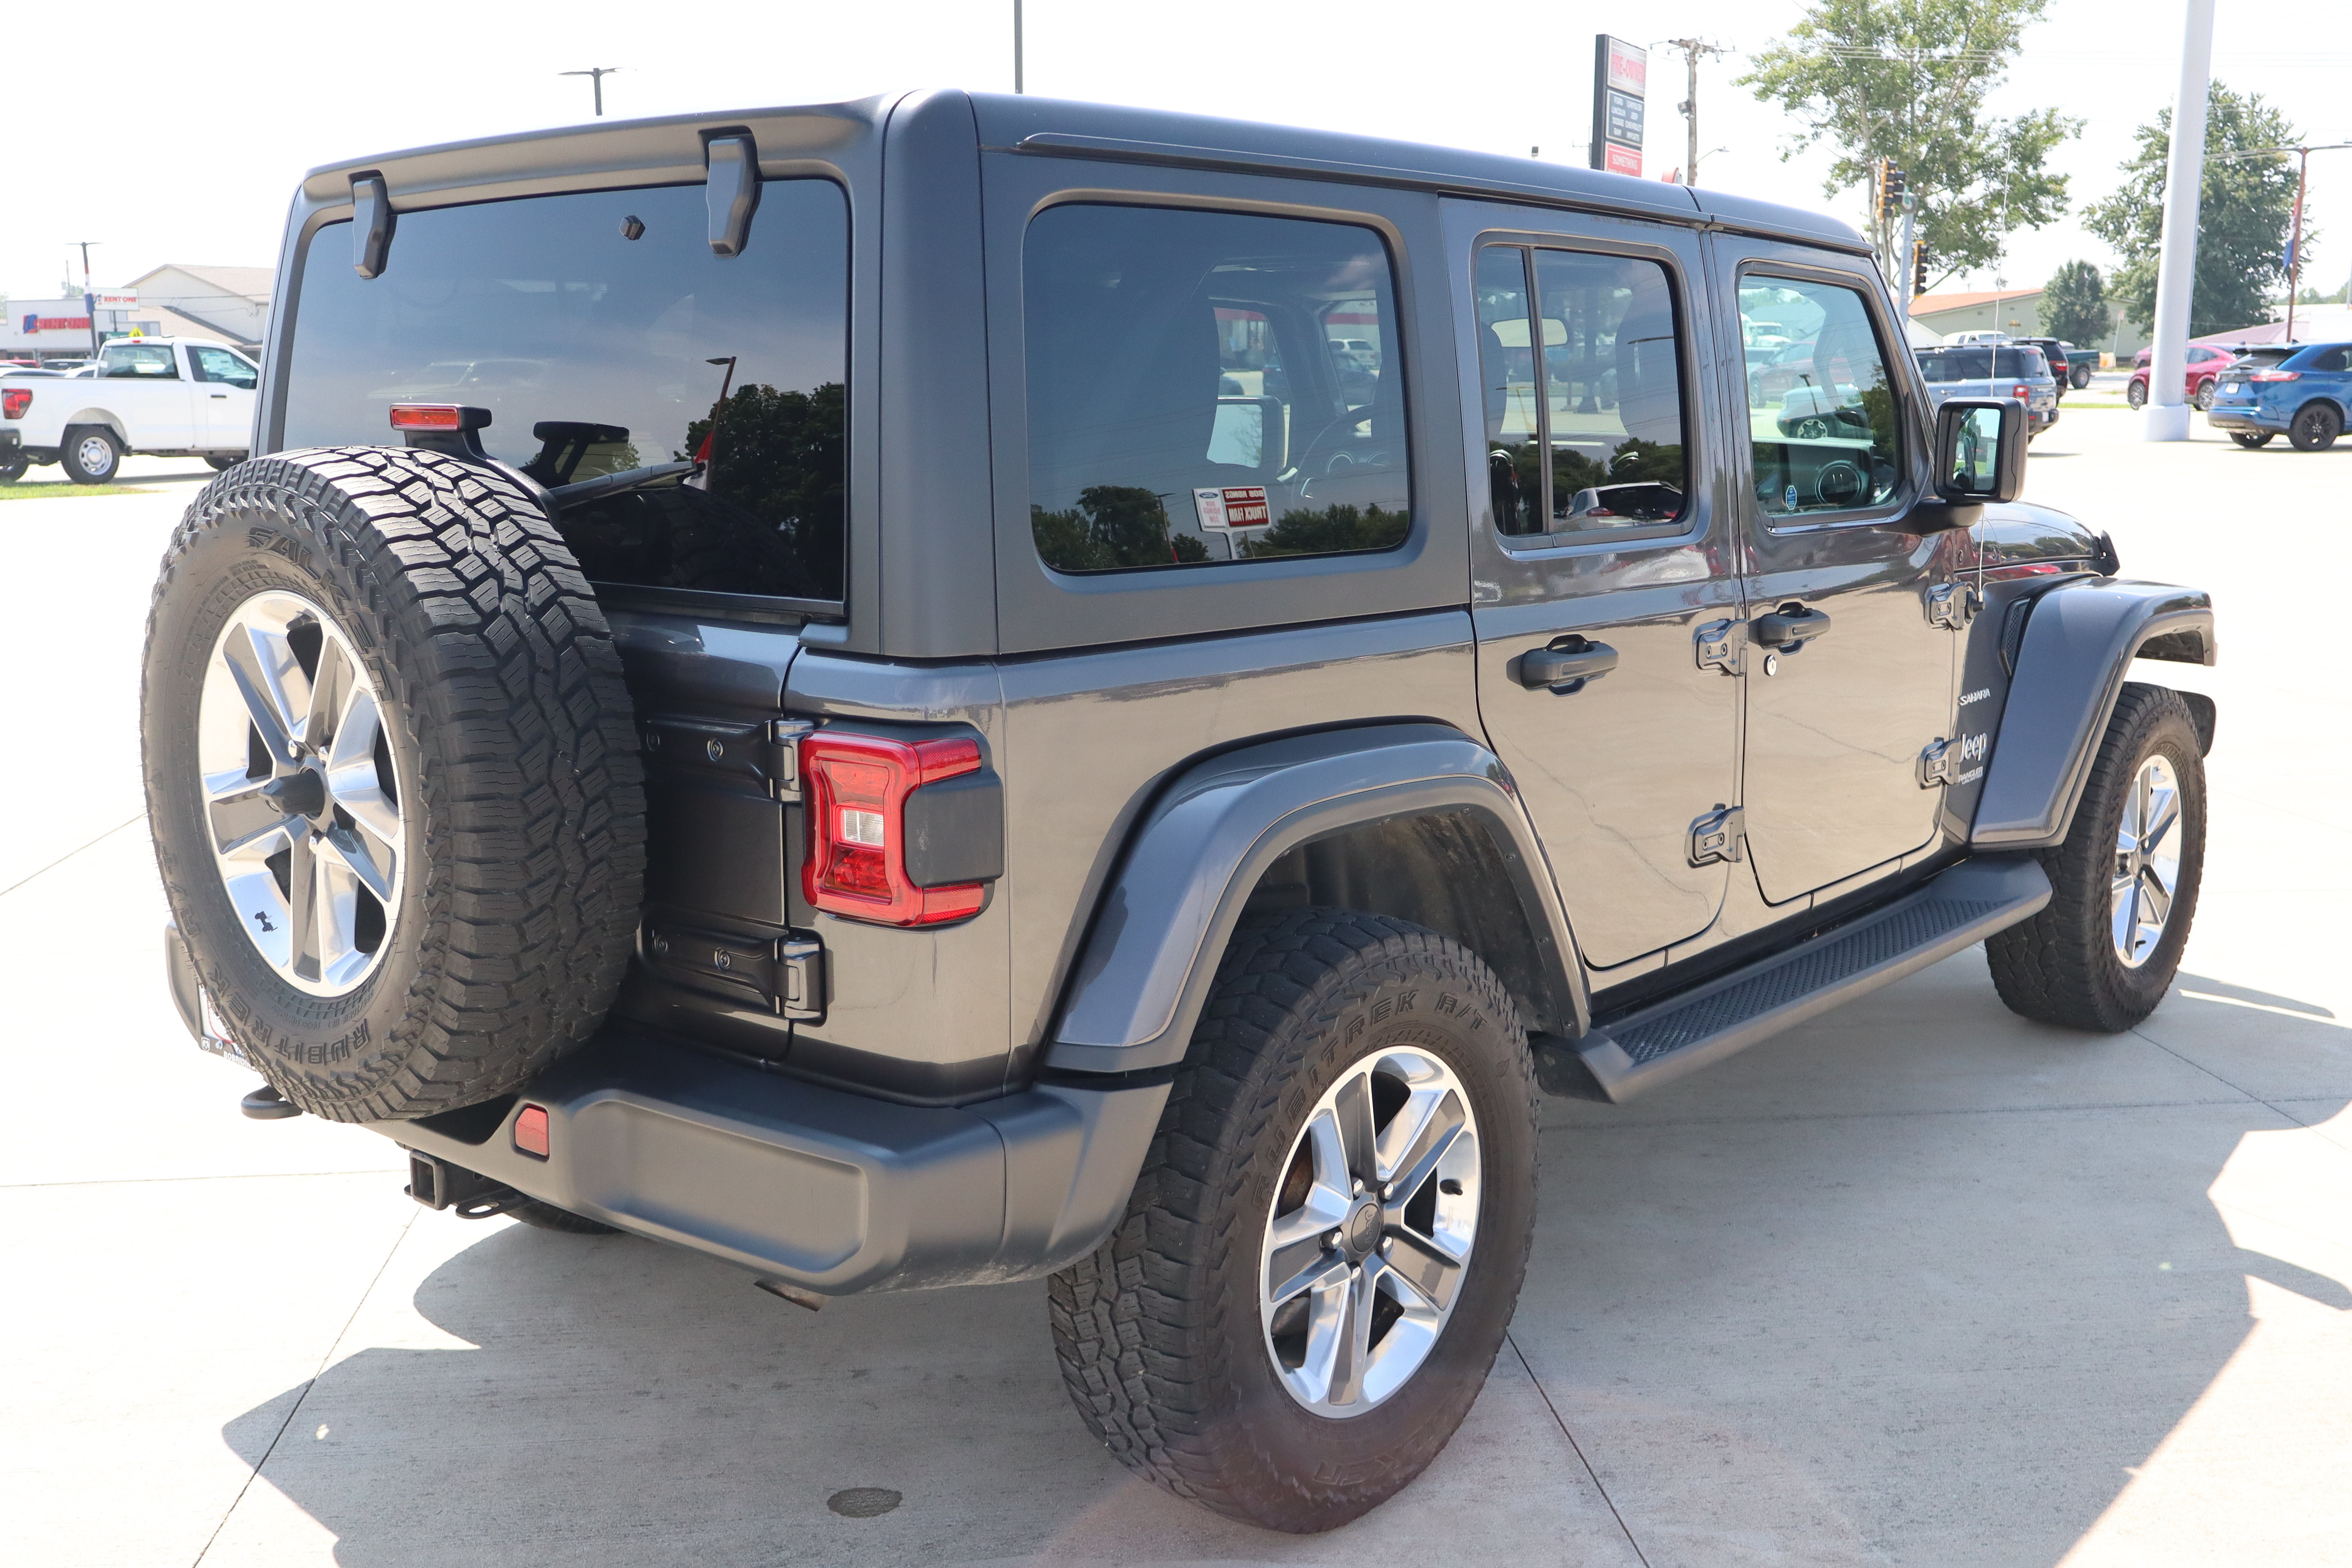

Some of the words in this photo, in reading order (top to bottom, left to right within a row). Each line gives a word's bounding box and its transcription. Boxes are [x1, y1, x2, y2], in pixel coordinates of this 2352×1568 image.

[1614, 96, 1624, 106] FORD
[1612, 116, 1624, 127] DODGE
[1612, 154, 1638, 170] SOMETHING
[39, 318, 67, 330] RENT
[1959, 688, 1991, 706] SAHARA
[1960, 733, 1988, 762] Jeep
[1959, 766, 1983, 783] RANGLER
[207, 964, 370, 1065] RUBITREK
[1252, 989, 1420, 1210] RUBITREK
[1434, 991, 1488, 1032] A/T
